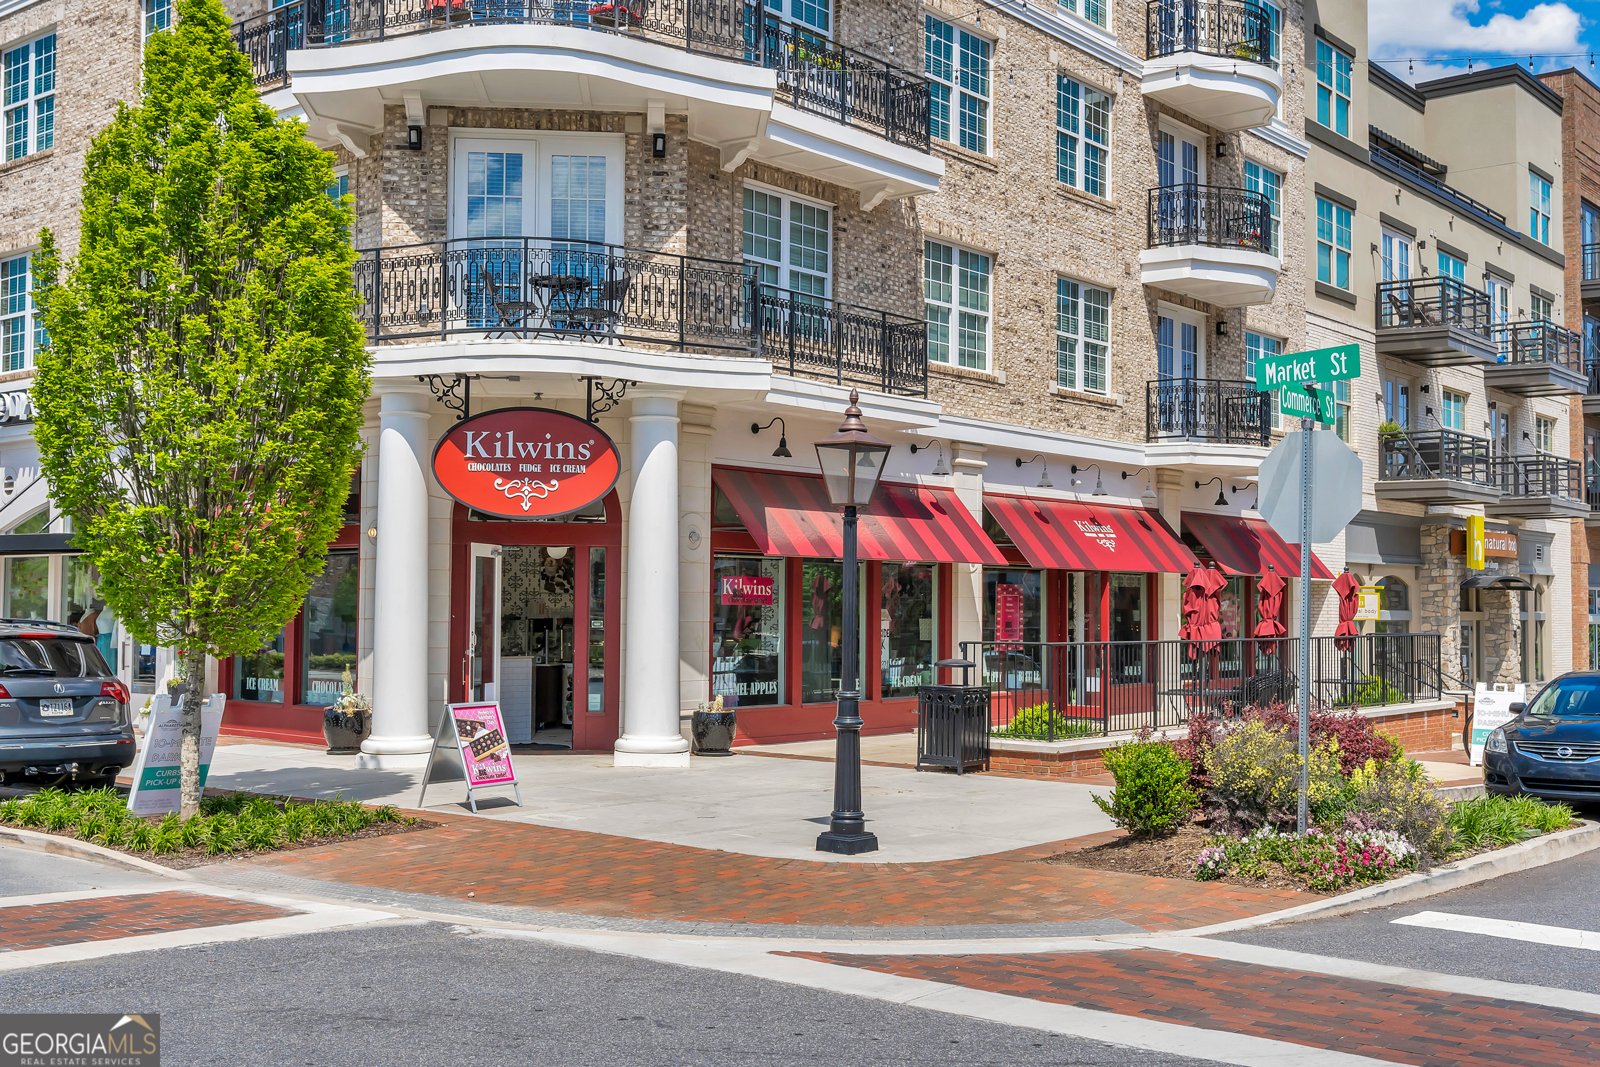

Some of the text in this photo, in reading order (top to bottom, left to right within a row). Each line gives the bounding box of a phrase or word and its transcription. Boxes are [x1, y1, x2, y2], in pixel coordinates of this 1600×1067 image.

[1265, 352, 1348, 385] Market St
[1281, 384, 1334, 418] Commerce St
[467, 462, 586, 474] CHOCOLATES FUDGE ICE CREAM
[1073, 519, 1115, 534] Kilwins
[1484, 537, 1507, 551] natural
[722, 578, 772, 596] Kilwins
[246, 677, 279, 691] ICE CREAM
[749, 681, 778, 695] APPLES
[471, 762, 507, 775] Kilwins
[145, 778, 177, 786] PICK-UP
